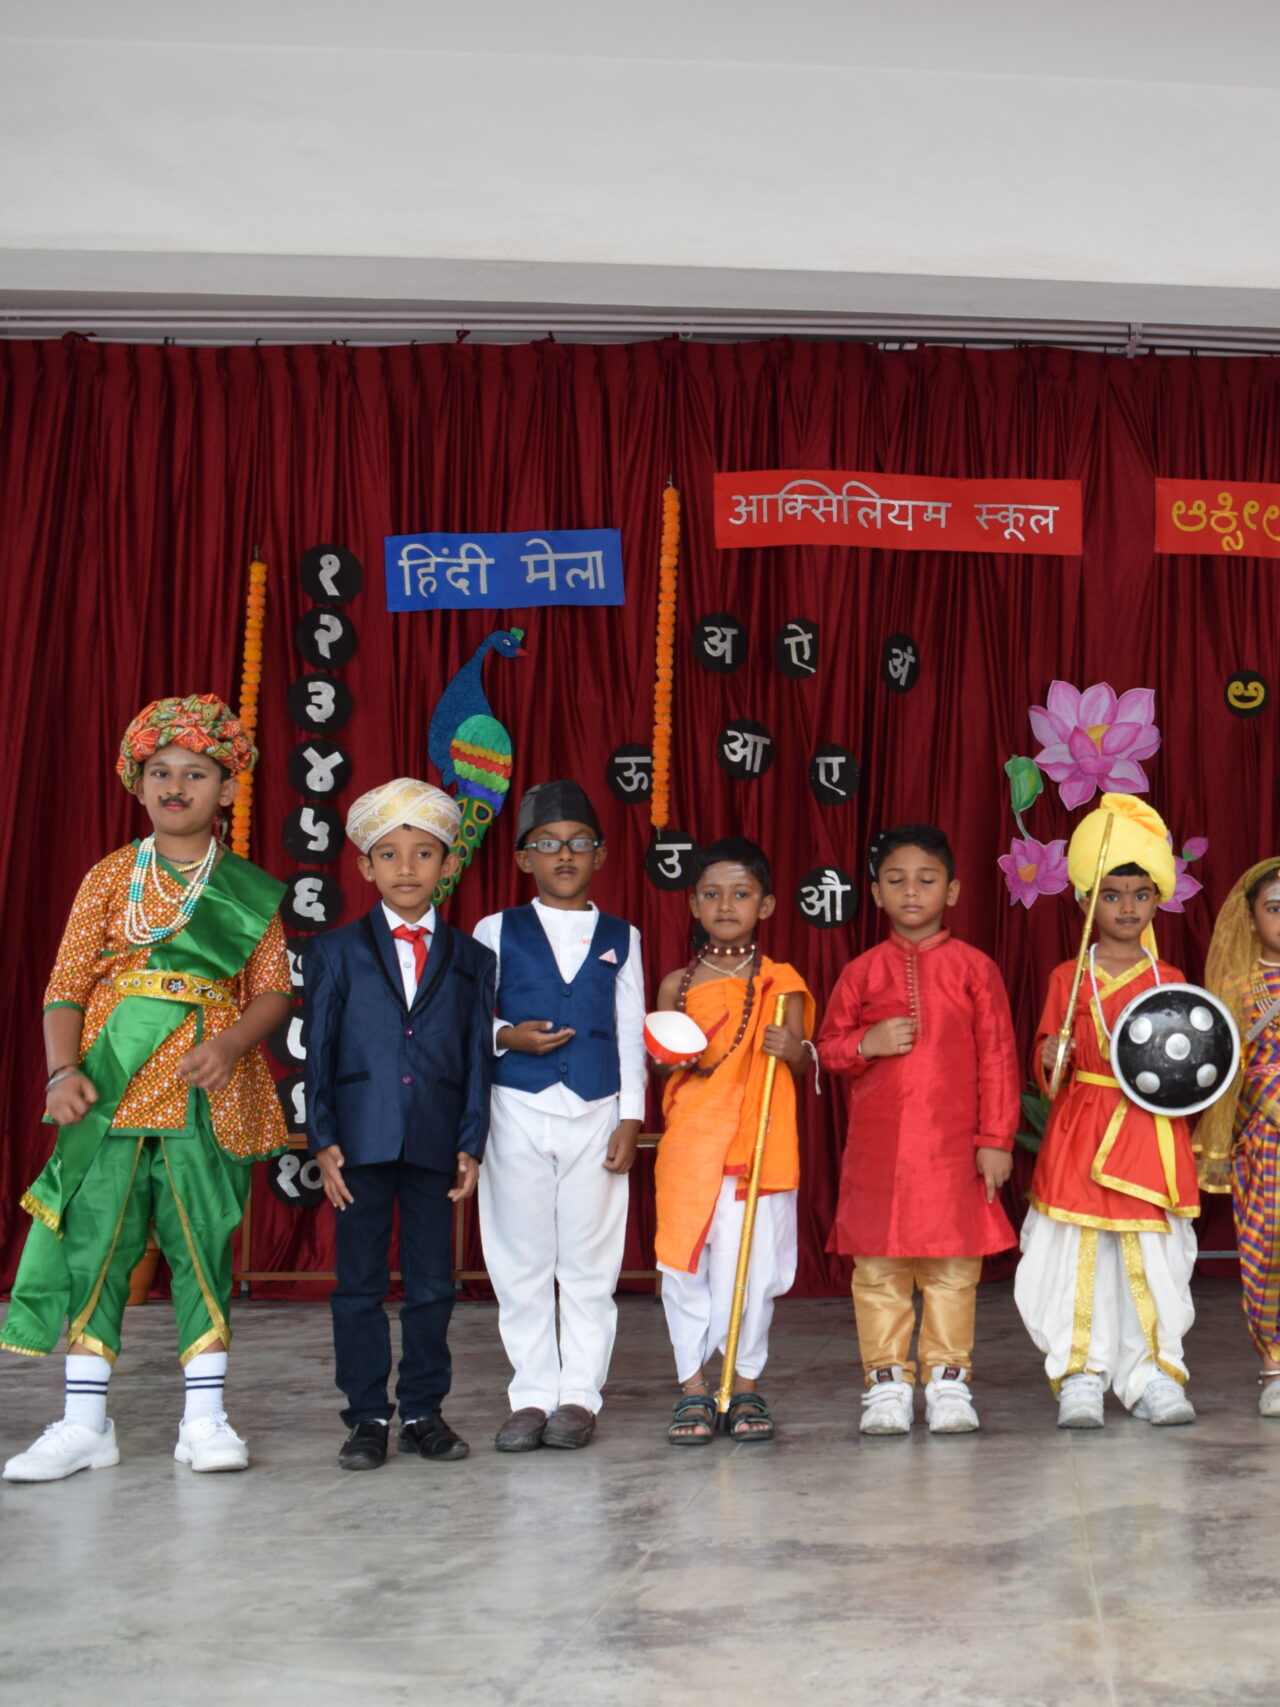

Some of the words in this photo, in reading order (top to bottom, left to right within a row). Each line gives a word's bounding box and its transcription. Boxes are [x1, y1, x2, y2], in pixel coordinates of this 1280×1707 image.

[974, 503, 1059, 542] स्कूल
[398, 543, 495, 598] हिंदी
[520, 538, 606, 591] मेला
[703, 626, 738, 665] अ
[1227, 680, 1265, 709] ಅ
[724, 730, 771, 774] आ
[816, 756, 846, 796] ए
[656, 843, 692, 879] उ
[801, 870, 850, 922] औ
